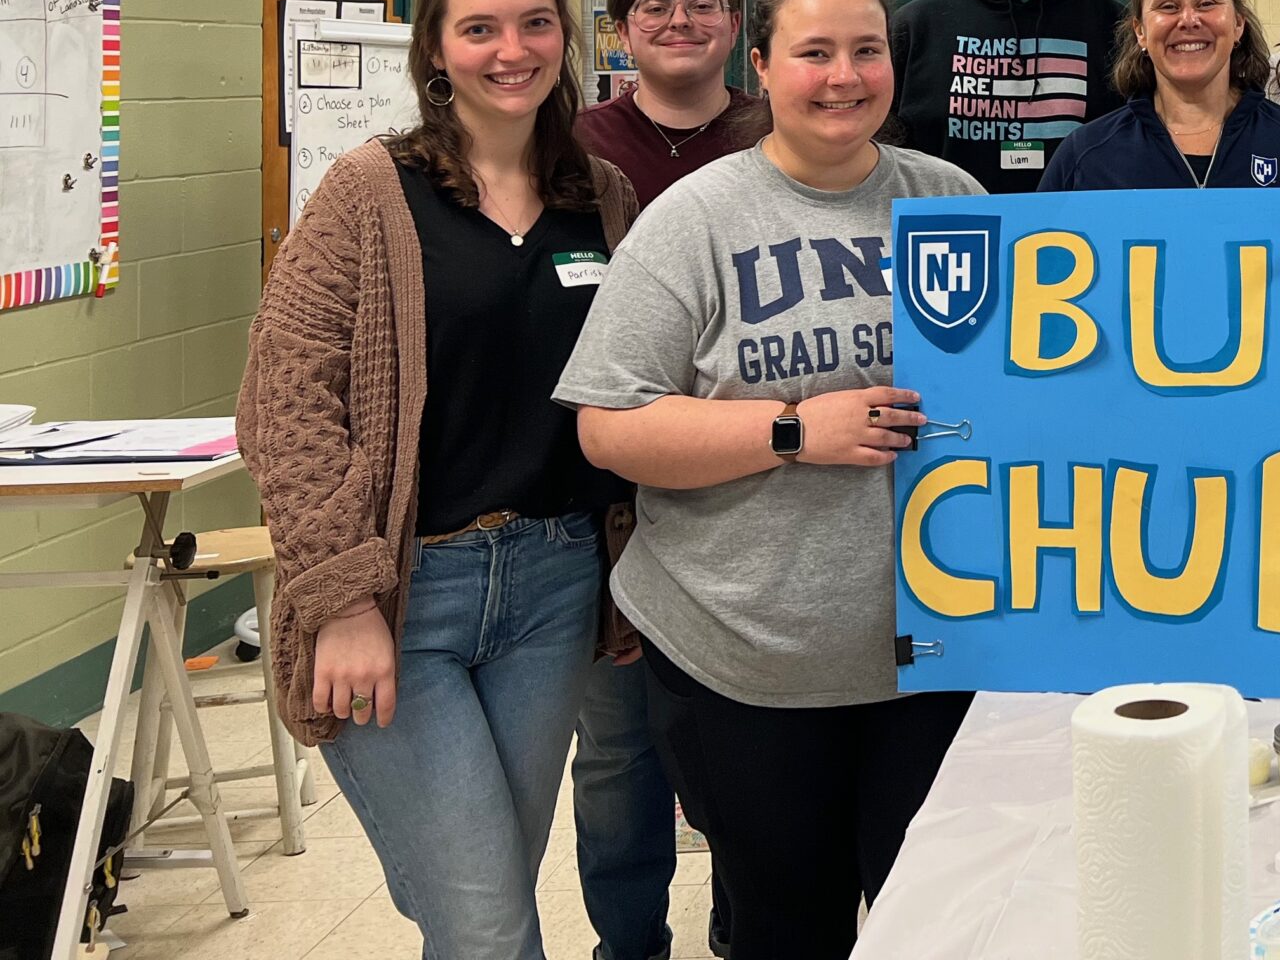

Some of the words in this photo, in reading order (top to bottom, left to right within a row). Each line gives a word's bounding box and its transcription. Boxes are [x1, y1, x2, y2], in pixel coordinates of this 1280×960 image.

[956, 35, 1018, 56] TRANS
[952, 54, 1024, 76] RIGHTS
[950, 75, 991, 95] ARE
[317, 94, 352, 111] Choose
[357, 100, 365, 108] a
[369, 94, 391, 116] plan
[949, 95, 1016, 119] HUMAN
[337, 113, 370, 129] Sheet
[948, 117, 1022, 141] RIGHTS
[1009, 154, 1029, 165] Liam
[569, 252, 595, 260] HELLO
[737, 326, 841, 385] GRAD
